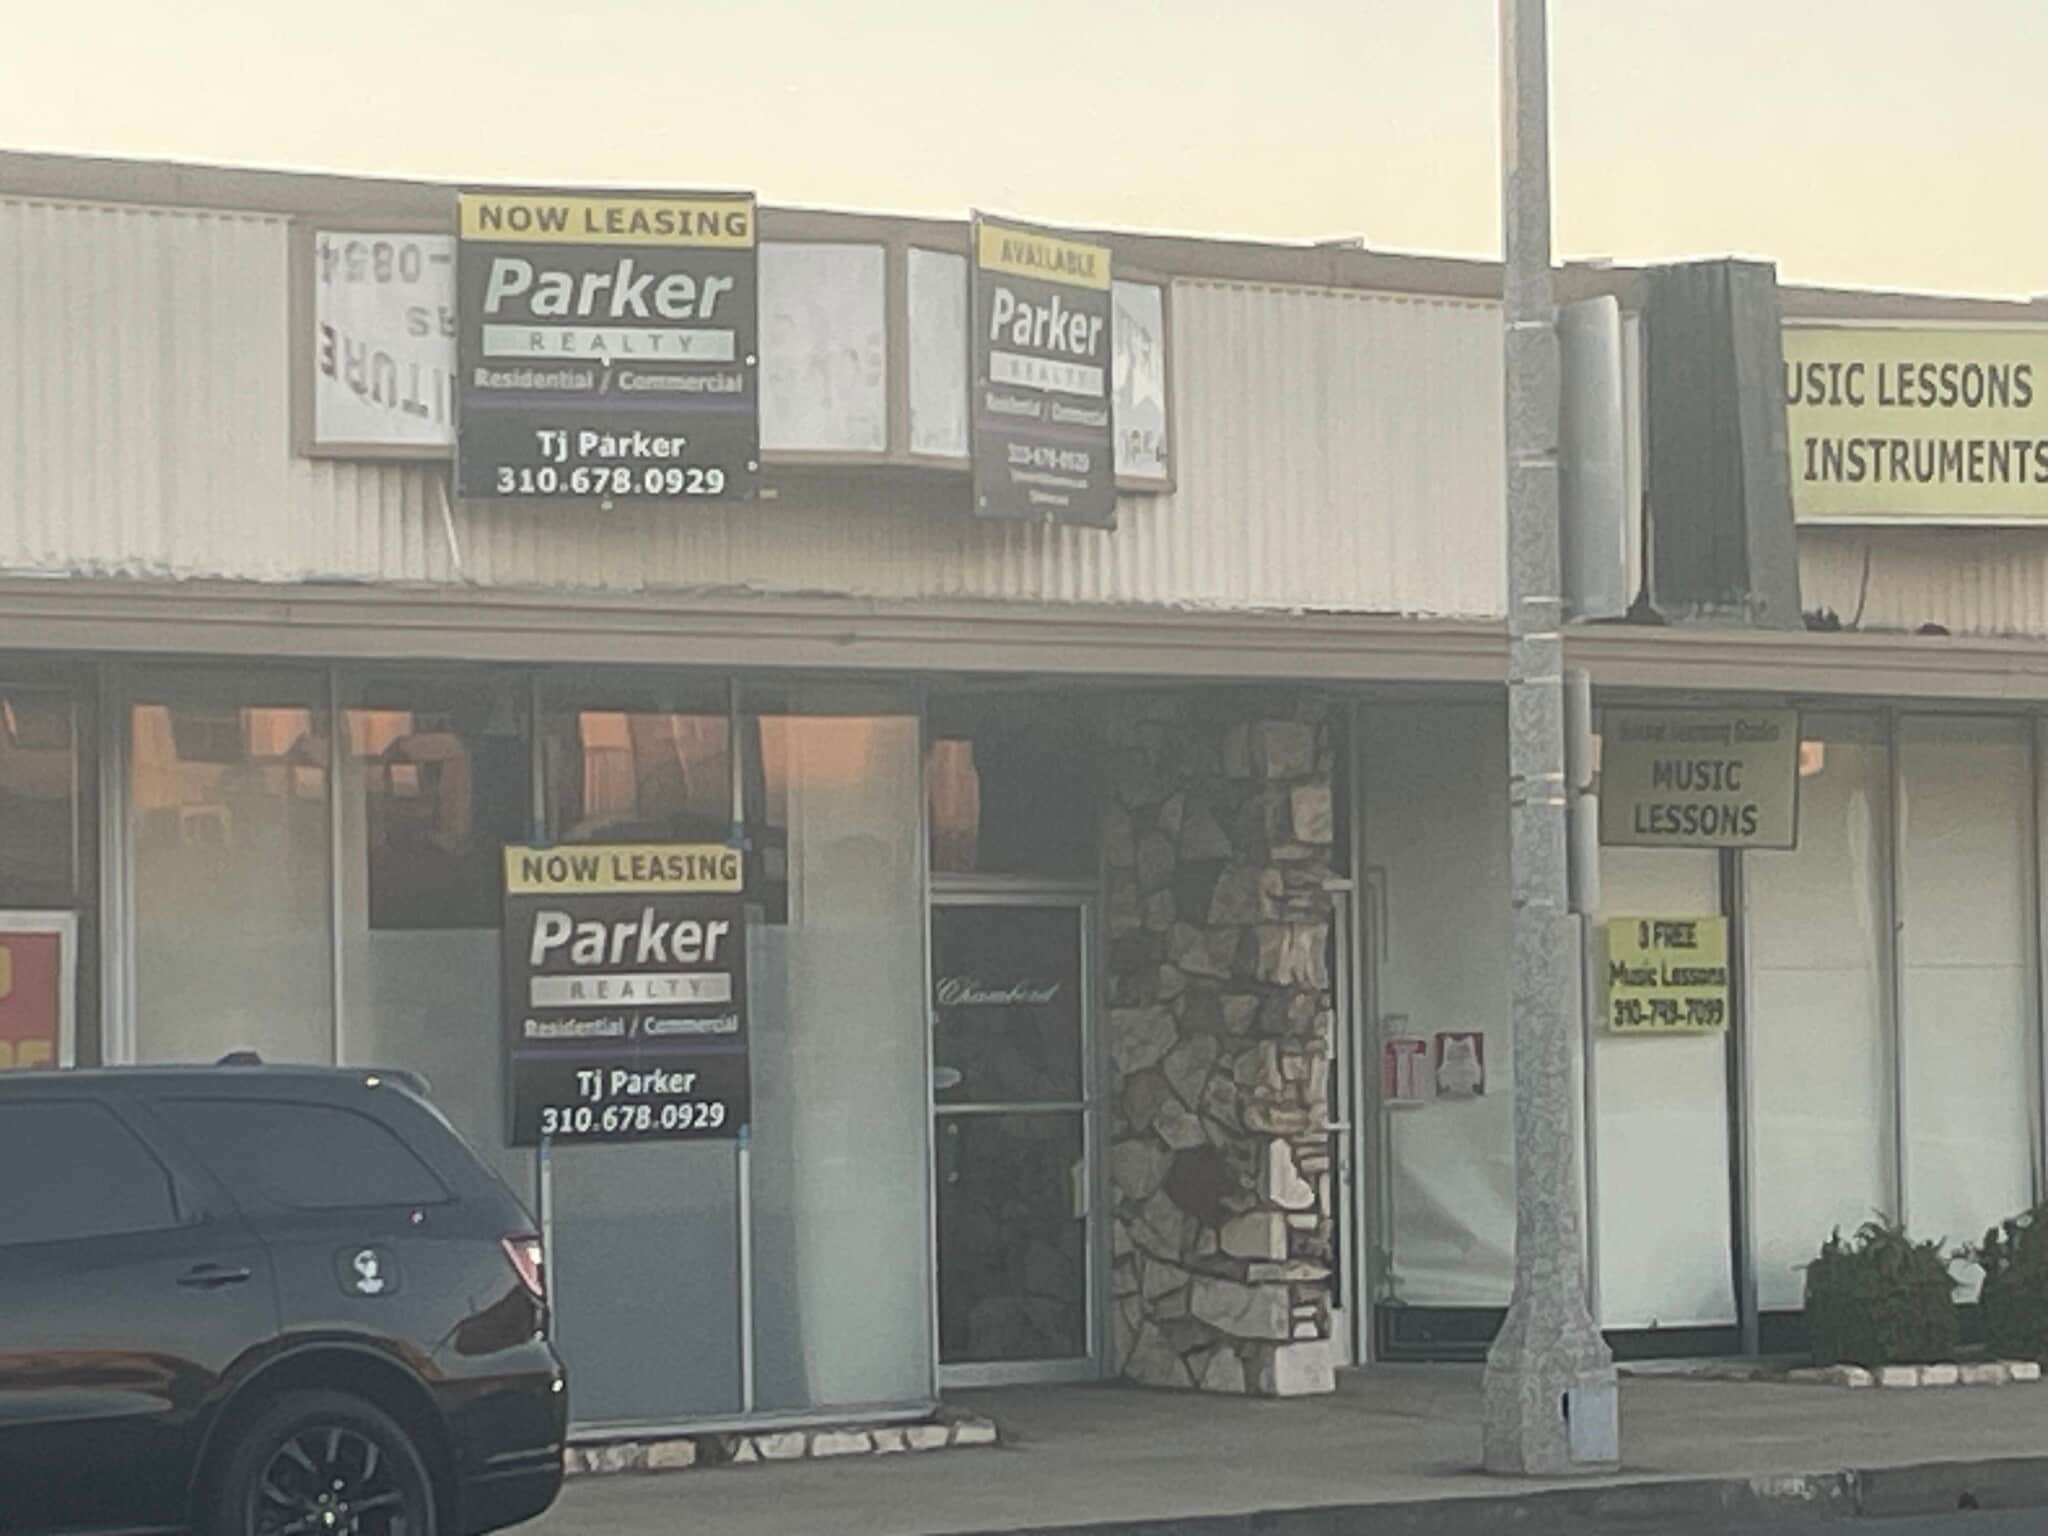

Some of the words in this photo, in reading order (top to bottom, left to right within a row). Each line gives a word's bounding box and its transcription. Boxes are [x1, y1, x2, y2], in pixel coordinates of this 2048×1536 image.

[478, 205, 569, 233] NOW
[585, 207, 748, 238] LEASING
[1002, 239, 1097, 279] AVAILABLE
[483, 256, 734, 319] Parker
[989, 287, 1104, 357] Parker
[529, 331, 695, 355] REALTY
[321, 321, 456, 426] ITURE
[474, 366, 594, 391] Residential
[618, 370, 744, 395] Commercial
[1784, 361, 1866, 408] USIC
[1877, 361, 2034, 409] LESSONS
[537, 431, 568, 458] Tj
[579, 431, 687, 457] Parker
[1803, 437, 2048, 484] INSTRUMENTS
[497, 467, 726, 496] 310.678.0929
[1652, 760, 1744, 793] MUSIC
[1633, 803, 1759, 837] LESSONS
[522, 856, 600, 884] NOW
[612, 854, 738, 883] LEASING
[529, 906, 730, 966] Parker
[1653, 920, 1698, 950] FREE
[571, 979, 701, 1000] REALTY
[1608, 959, 1658, 988] Music
[524, 1017, 625, 1038] Residential
[643, 1014, 739, 1036] Commercial
[576, 1069, 603, 1101] Tj
[610, 1068, 696, 1096] Parker
[541, 1102, 725, 1135] 310.678.0929
